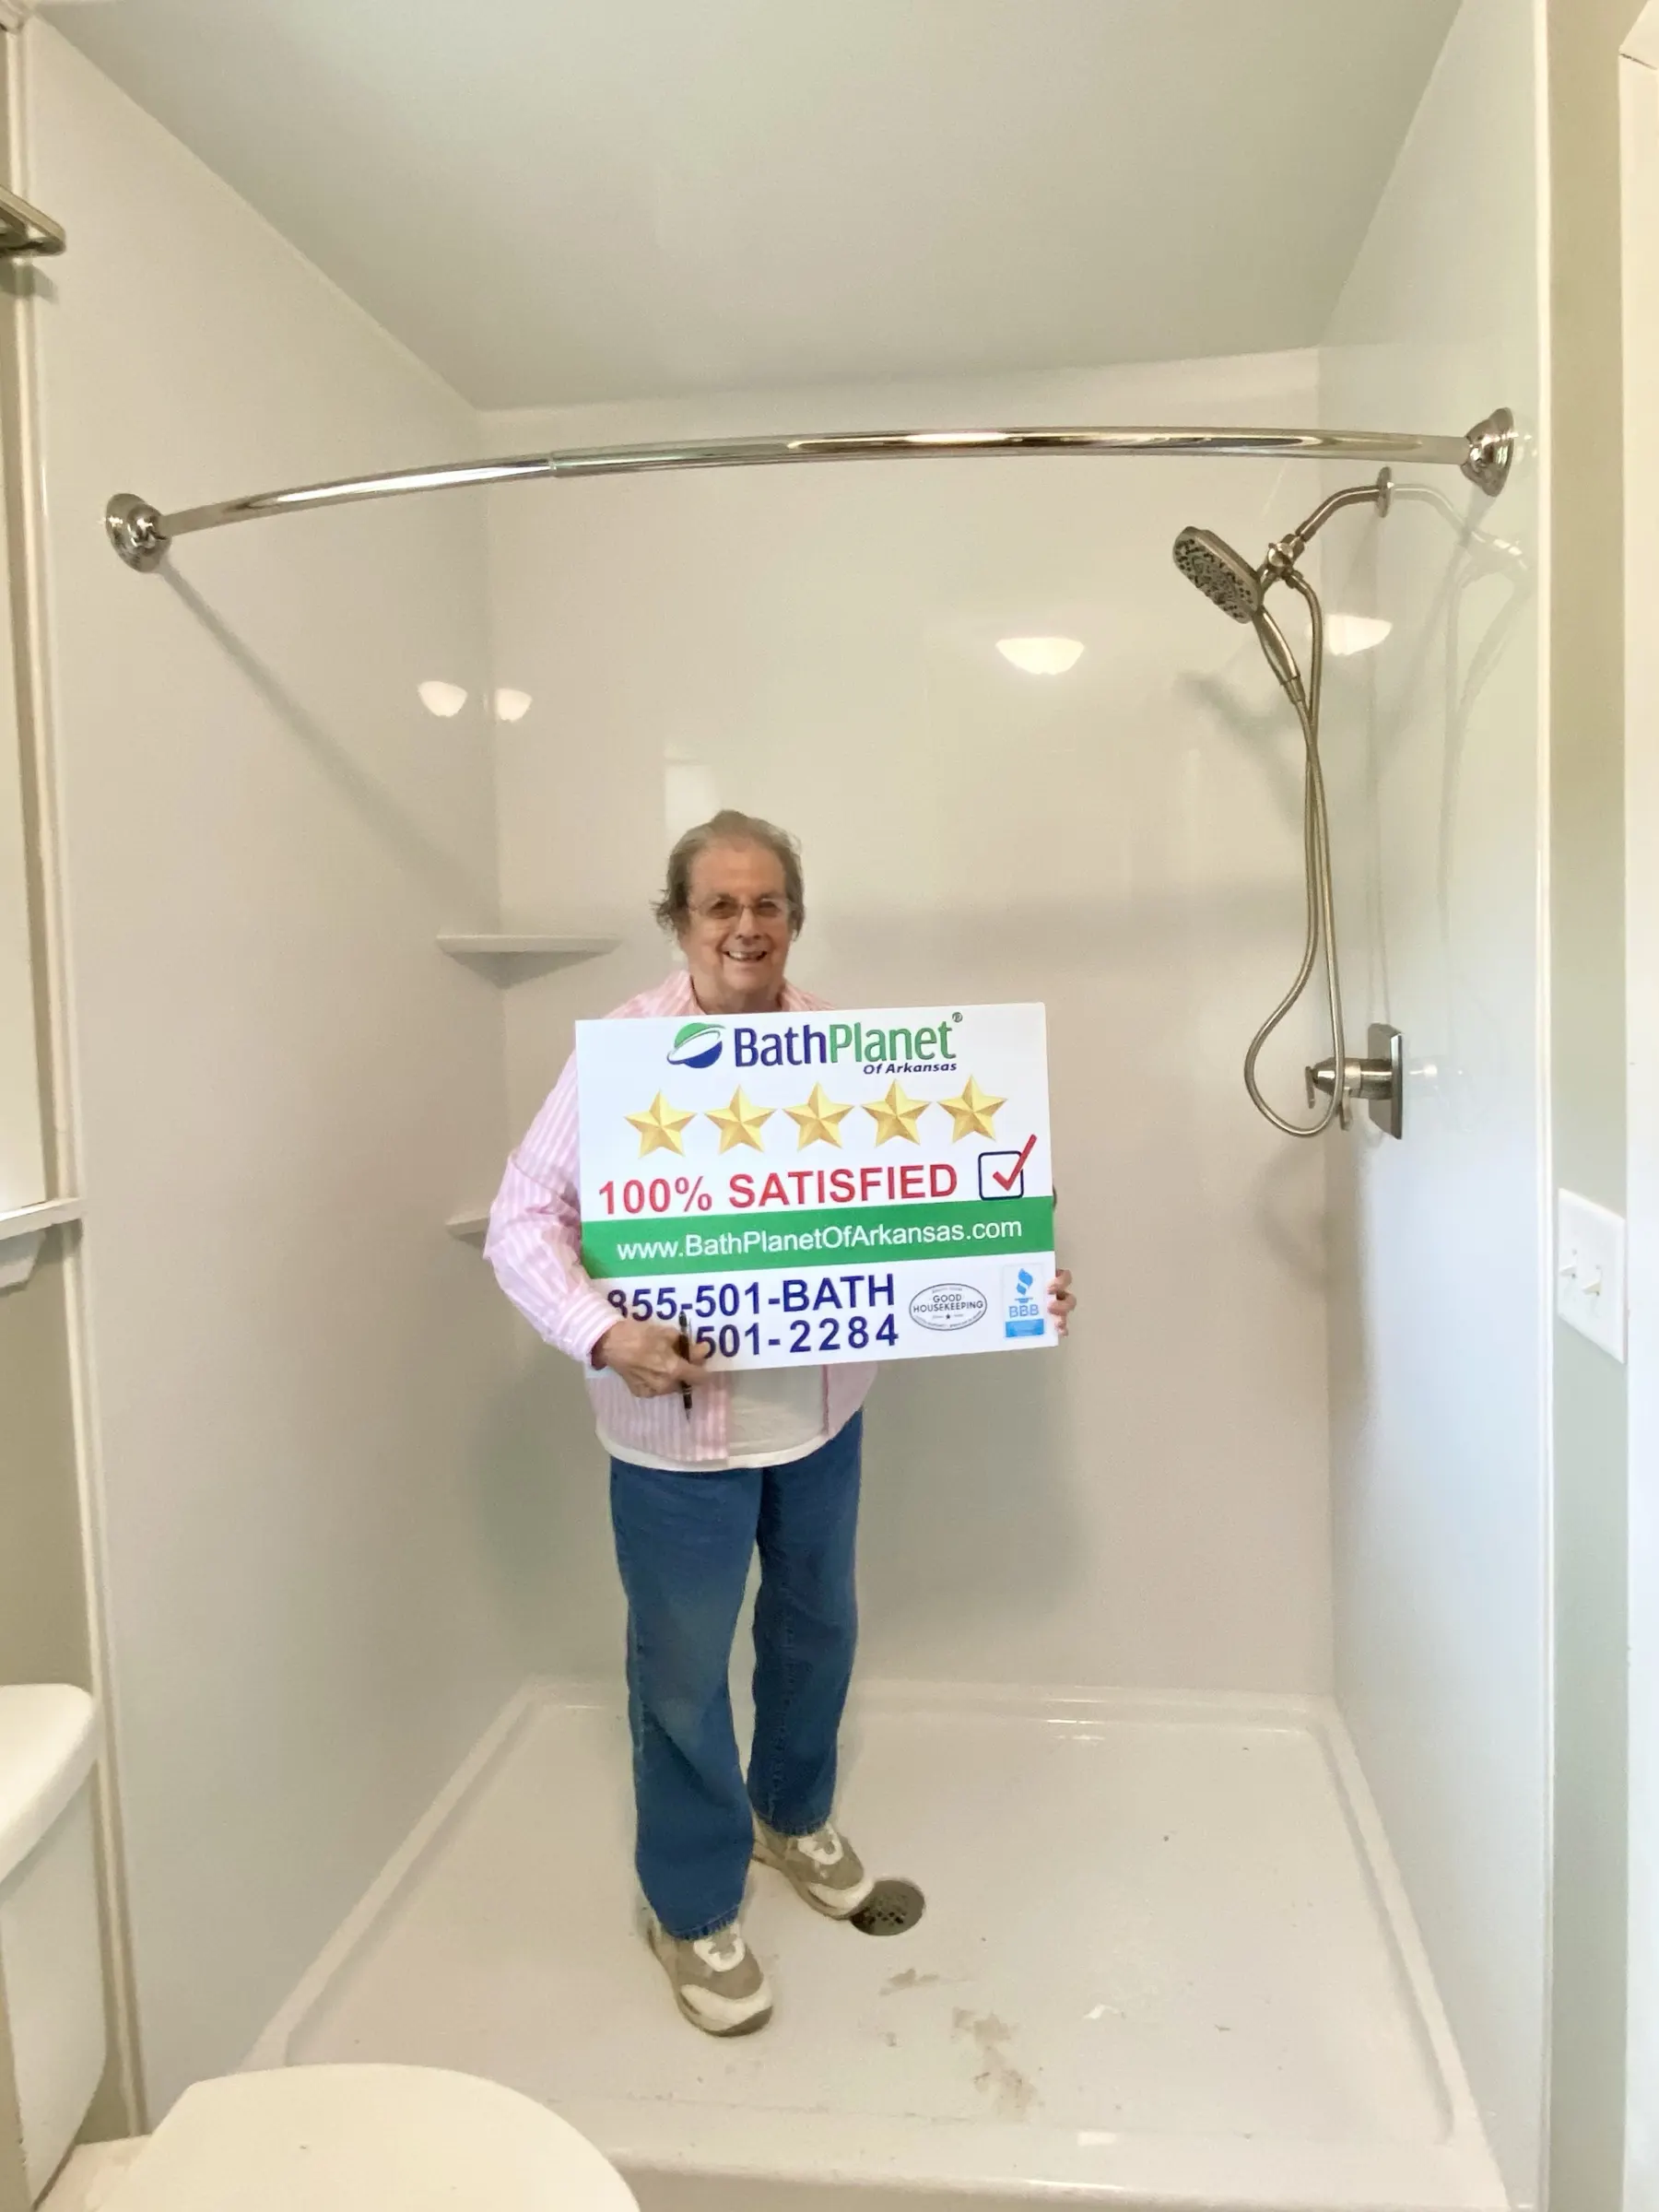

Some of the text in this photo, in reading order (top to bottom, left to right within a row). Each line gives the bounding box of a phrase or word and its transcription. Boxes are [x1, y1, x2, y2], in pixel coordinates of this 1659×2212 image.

[863, 1062, 959, 1076] Of Arkansas
[599, 1164, 958, 1214] 100% SATISFIED
[618, 1219, 1022, 1260] www.BathPlanetOfArkansas.com
[607, 1274, 895, 1321] 855-501-BATH
[933, 1294, 962, 1303] GOOD
[913, 1300, 983, 1312] HOUSEKEEPING
[1008, 1304, 1040, 1318] BBB
